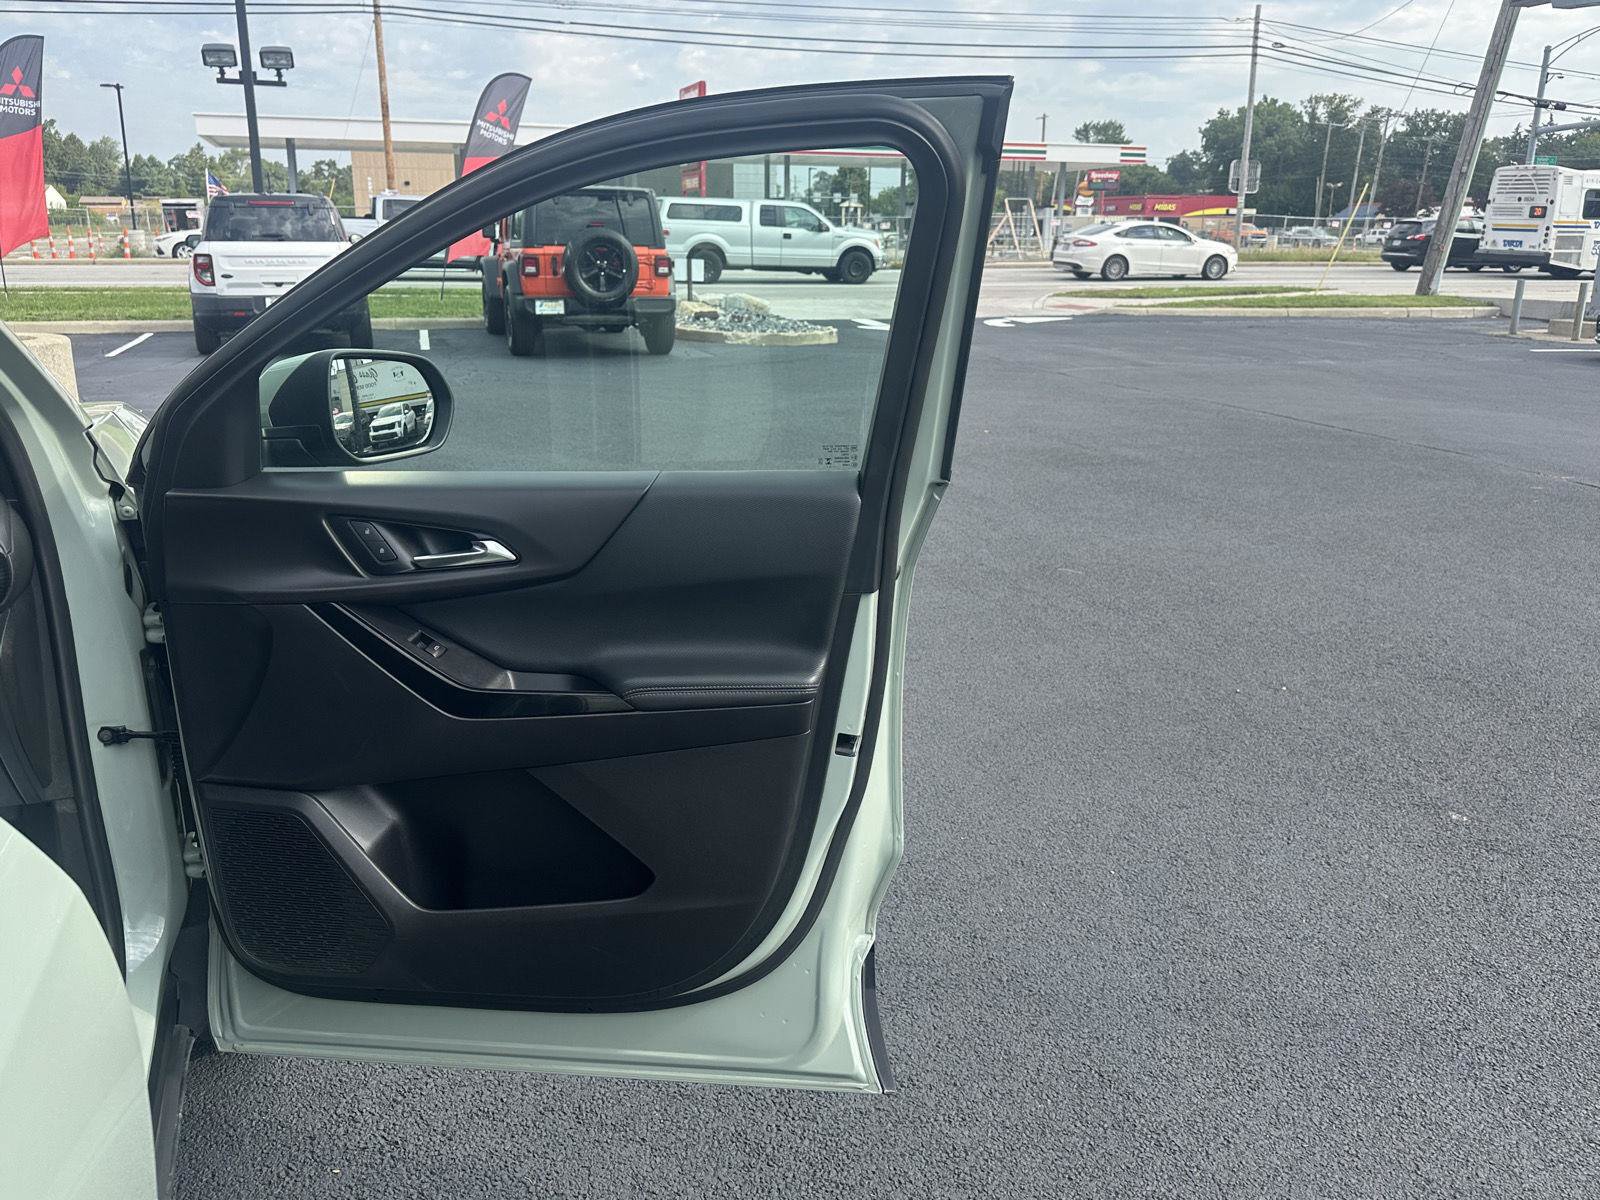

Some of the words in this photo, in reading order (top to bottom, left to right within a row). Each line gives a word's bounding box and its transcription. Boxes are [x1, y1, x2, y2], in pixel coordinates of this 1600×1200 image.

[0, 97, 41, 108] ITSUBISHI
[0, 105, 36, 116] MOTORS
[476, 120, 514, 140] MITSUBISHI
[480, 128, 507, 145] MOTORS
[1090, 171, 1119, 180] Speedway
[1534, 207, 1542, 216] 20
